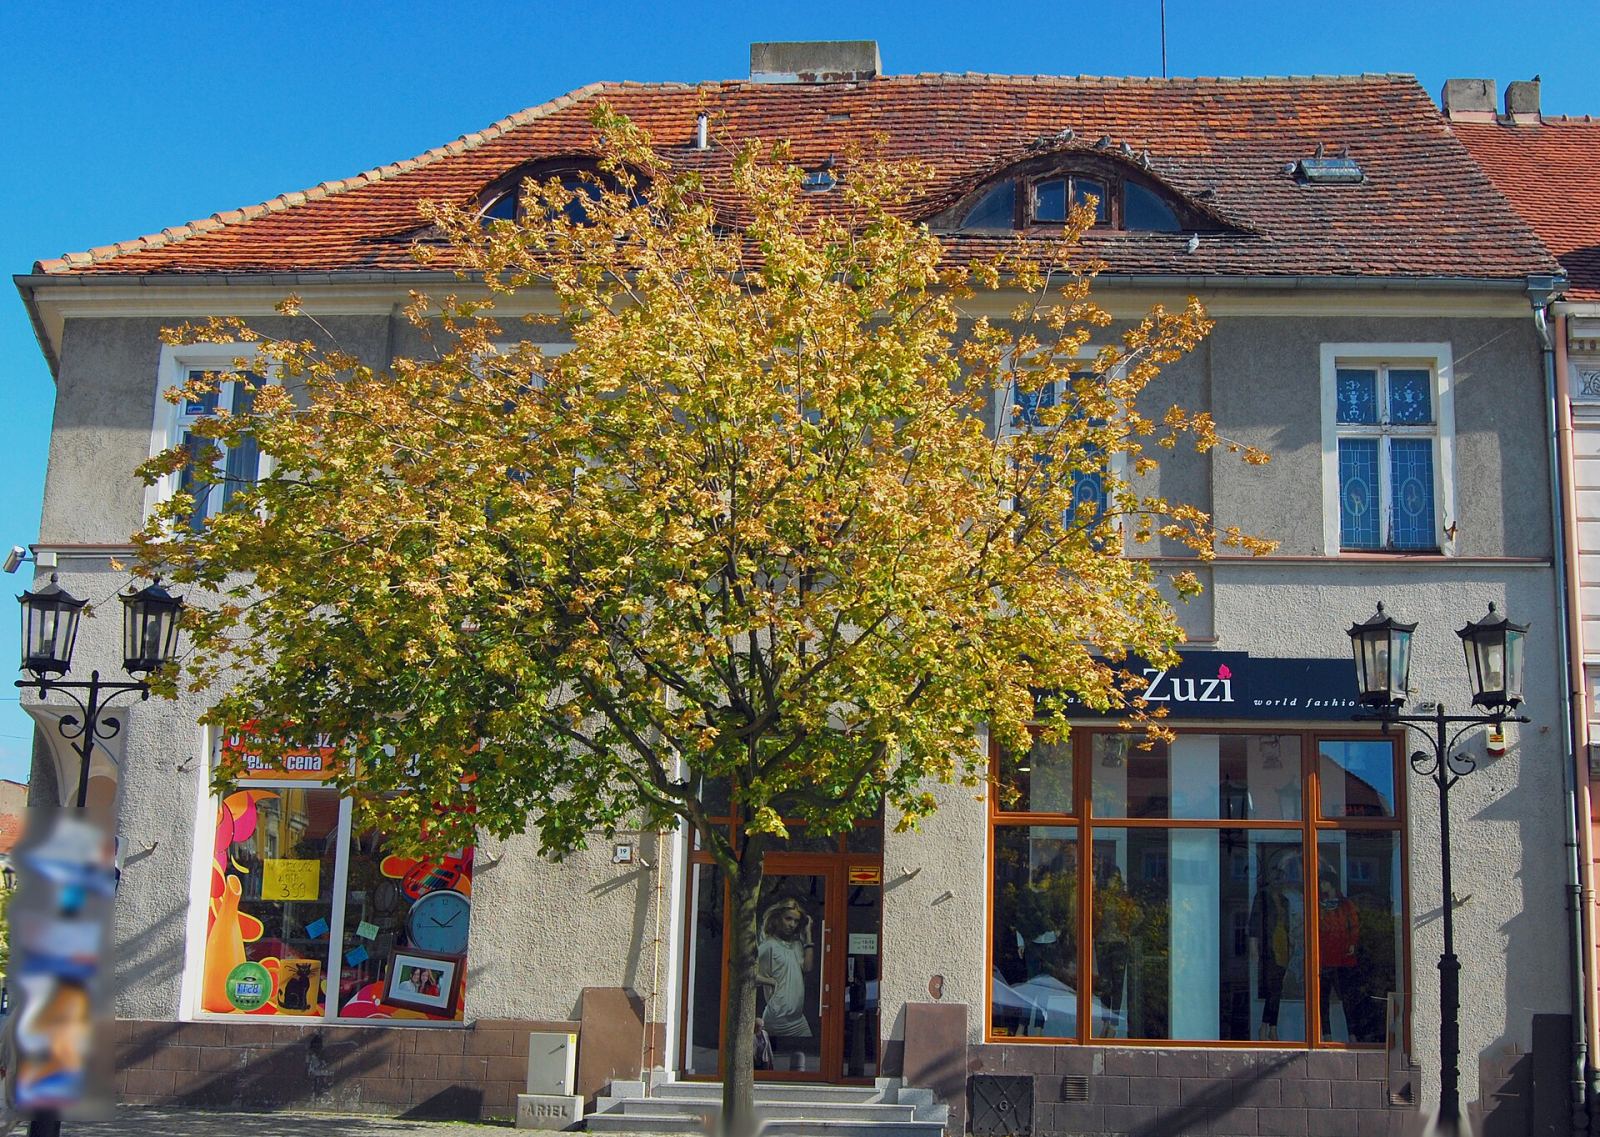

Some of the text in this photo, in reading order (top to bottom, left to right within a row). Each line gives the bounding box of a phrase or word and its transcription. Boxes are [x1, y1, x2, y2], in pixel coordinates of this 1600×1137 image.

[1142, 664, 1235, 702] Zuzi
[1253, 698, 1297, 706] world
[286, 756, 322, 770] cena
[999, 1099, 1009, 1111] G
